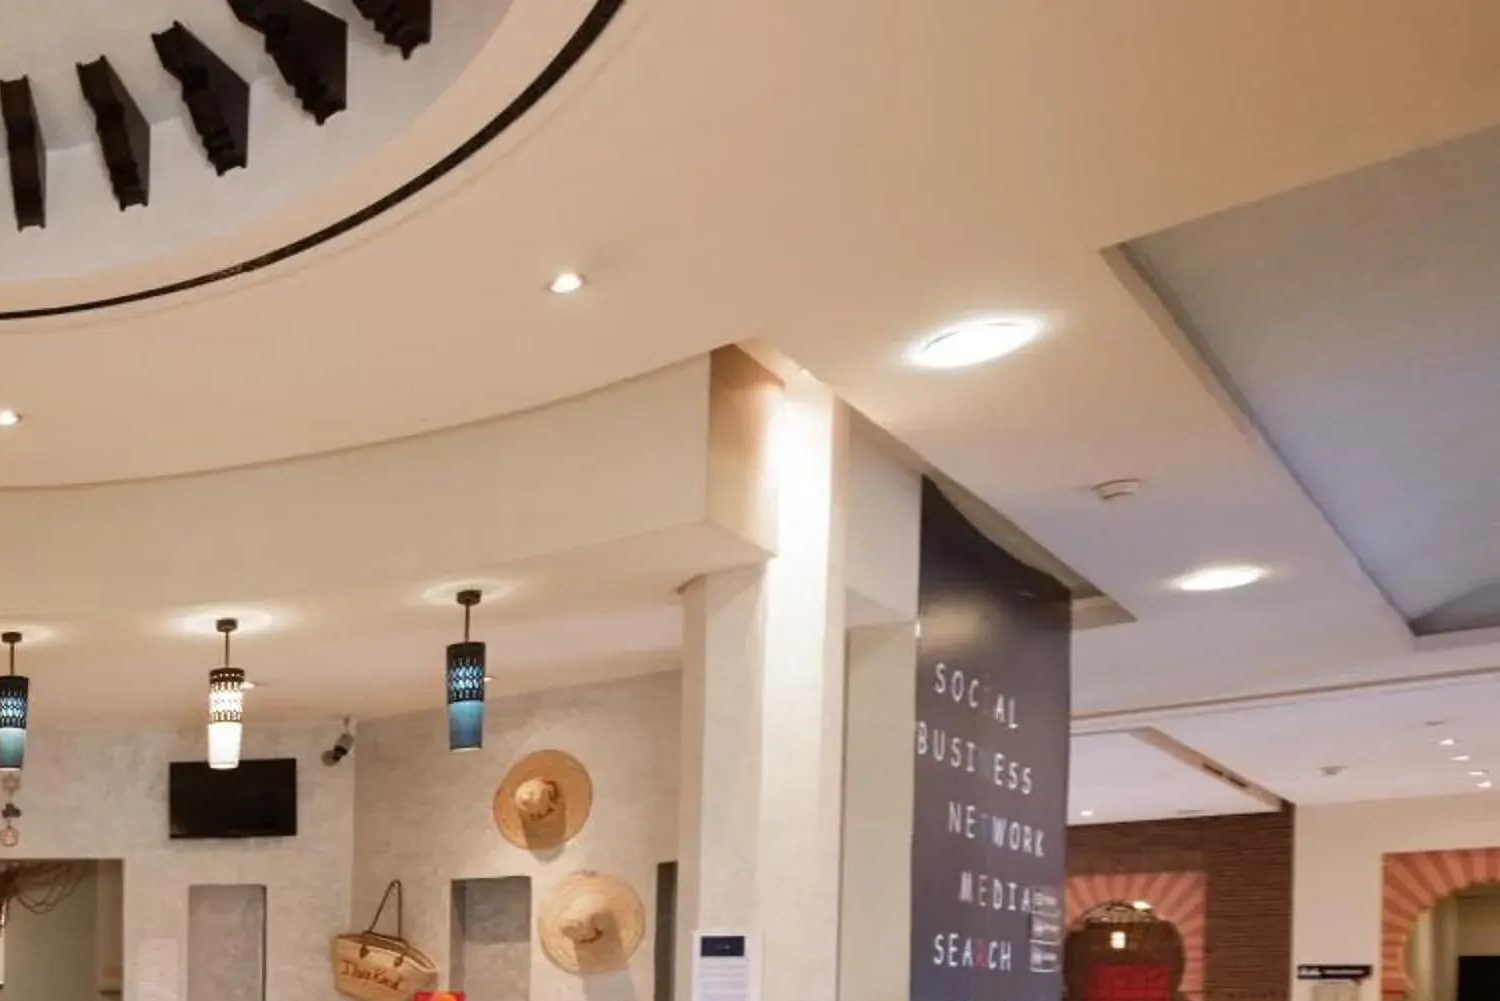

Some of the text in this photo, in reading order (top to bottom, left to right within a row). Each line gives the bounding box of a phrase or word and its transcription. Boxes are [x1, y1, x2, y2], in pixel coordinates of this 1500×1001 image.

[934, 662, 1019, 729] SOCAL
[917, 720, 1033, 795] BUSIESS
[959, 871, 1031, 912] MEDIA
[933, 933, 1011, 972] SEARCH
